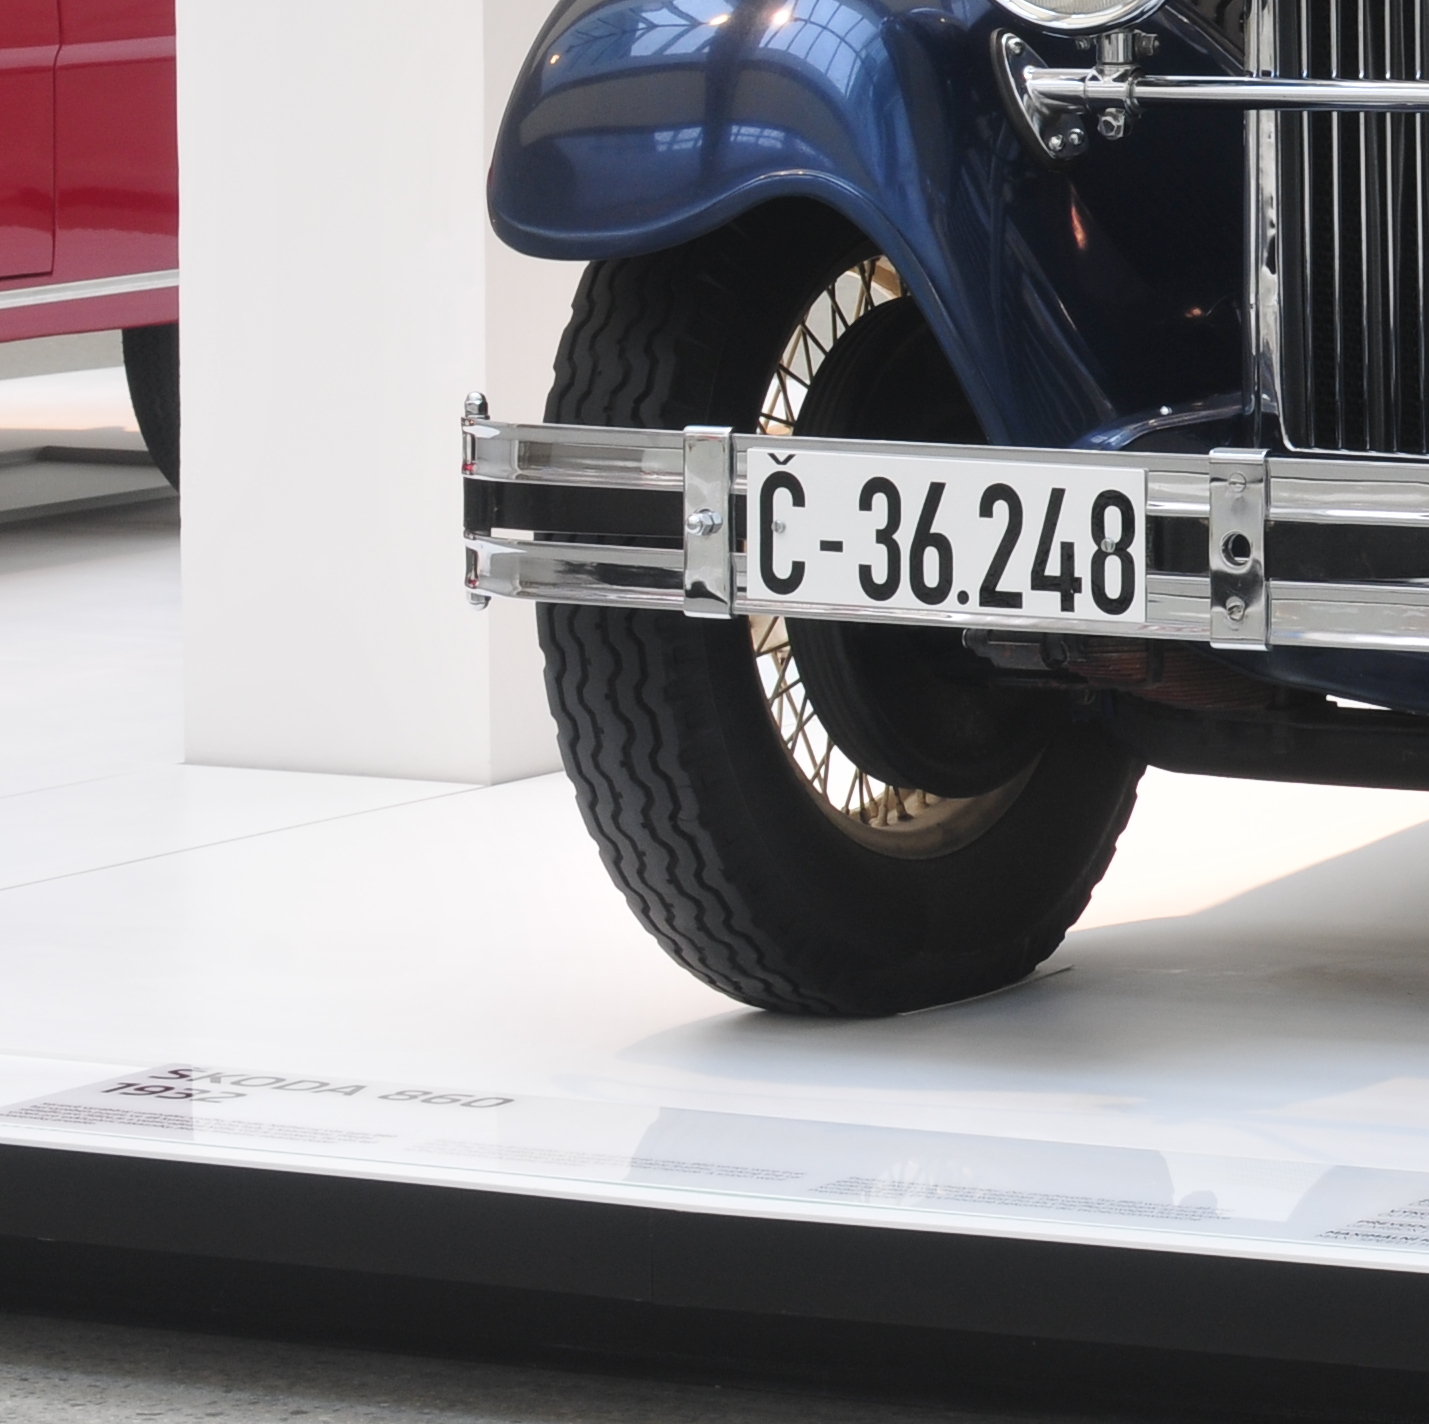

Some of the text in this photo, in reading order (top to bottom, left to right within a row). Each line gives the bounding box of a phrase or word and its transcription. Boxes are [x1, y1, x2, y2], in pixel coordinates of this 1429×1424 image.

[759, 452, 1136, 616] Č-36.248
[101, 1082, 248, 1104] 1932
[148, 1065, 516, 1109] ŠKODA 860
